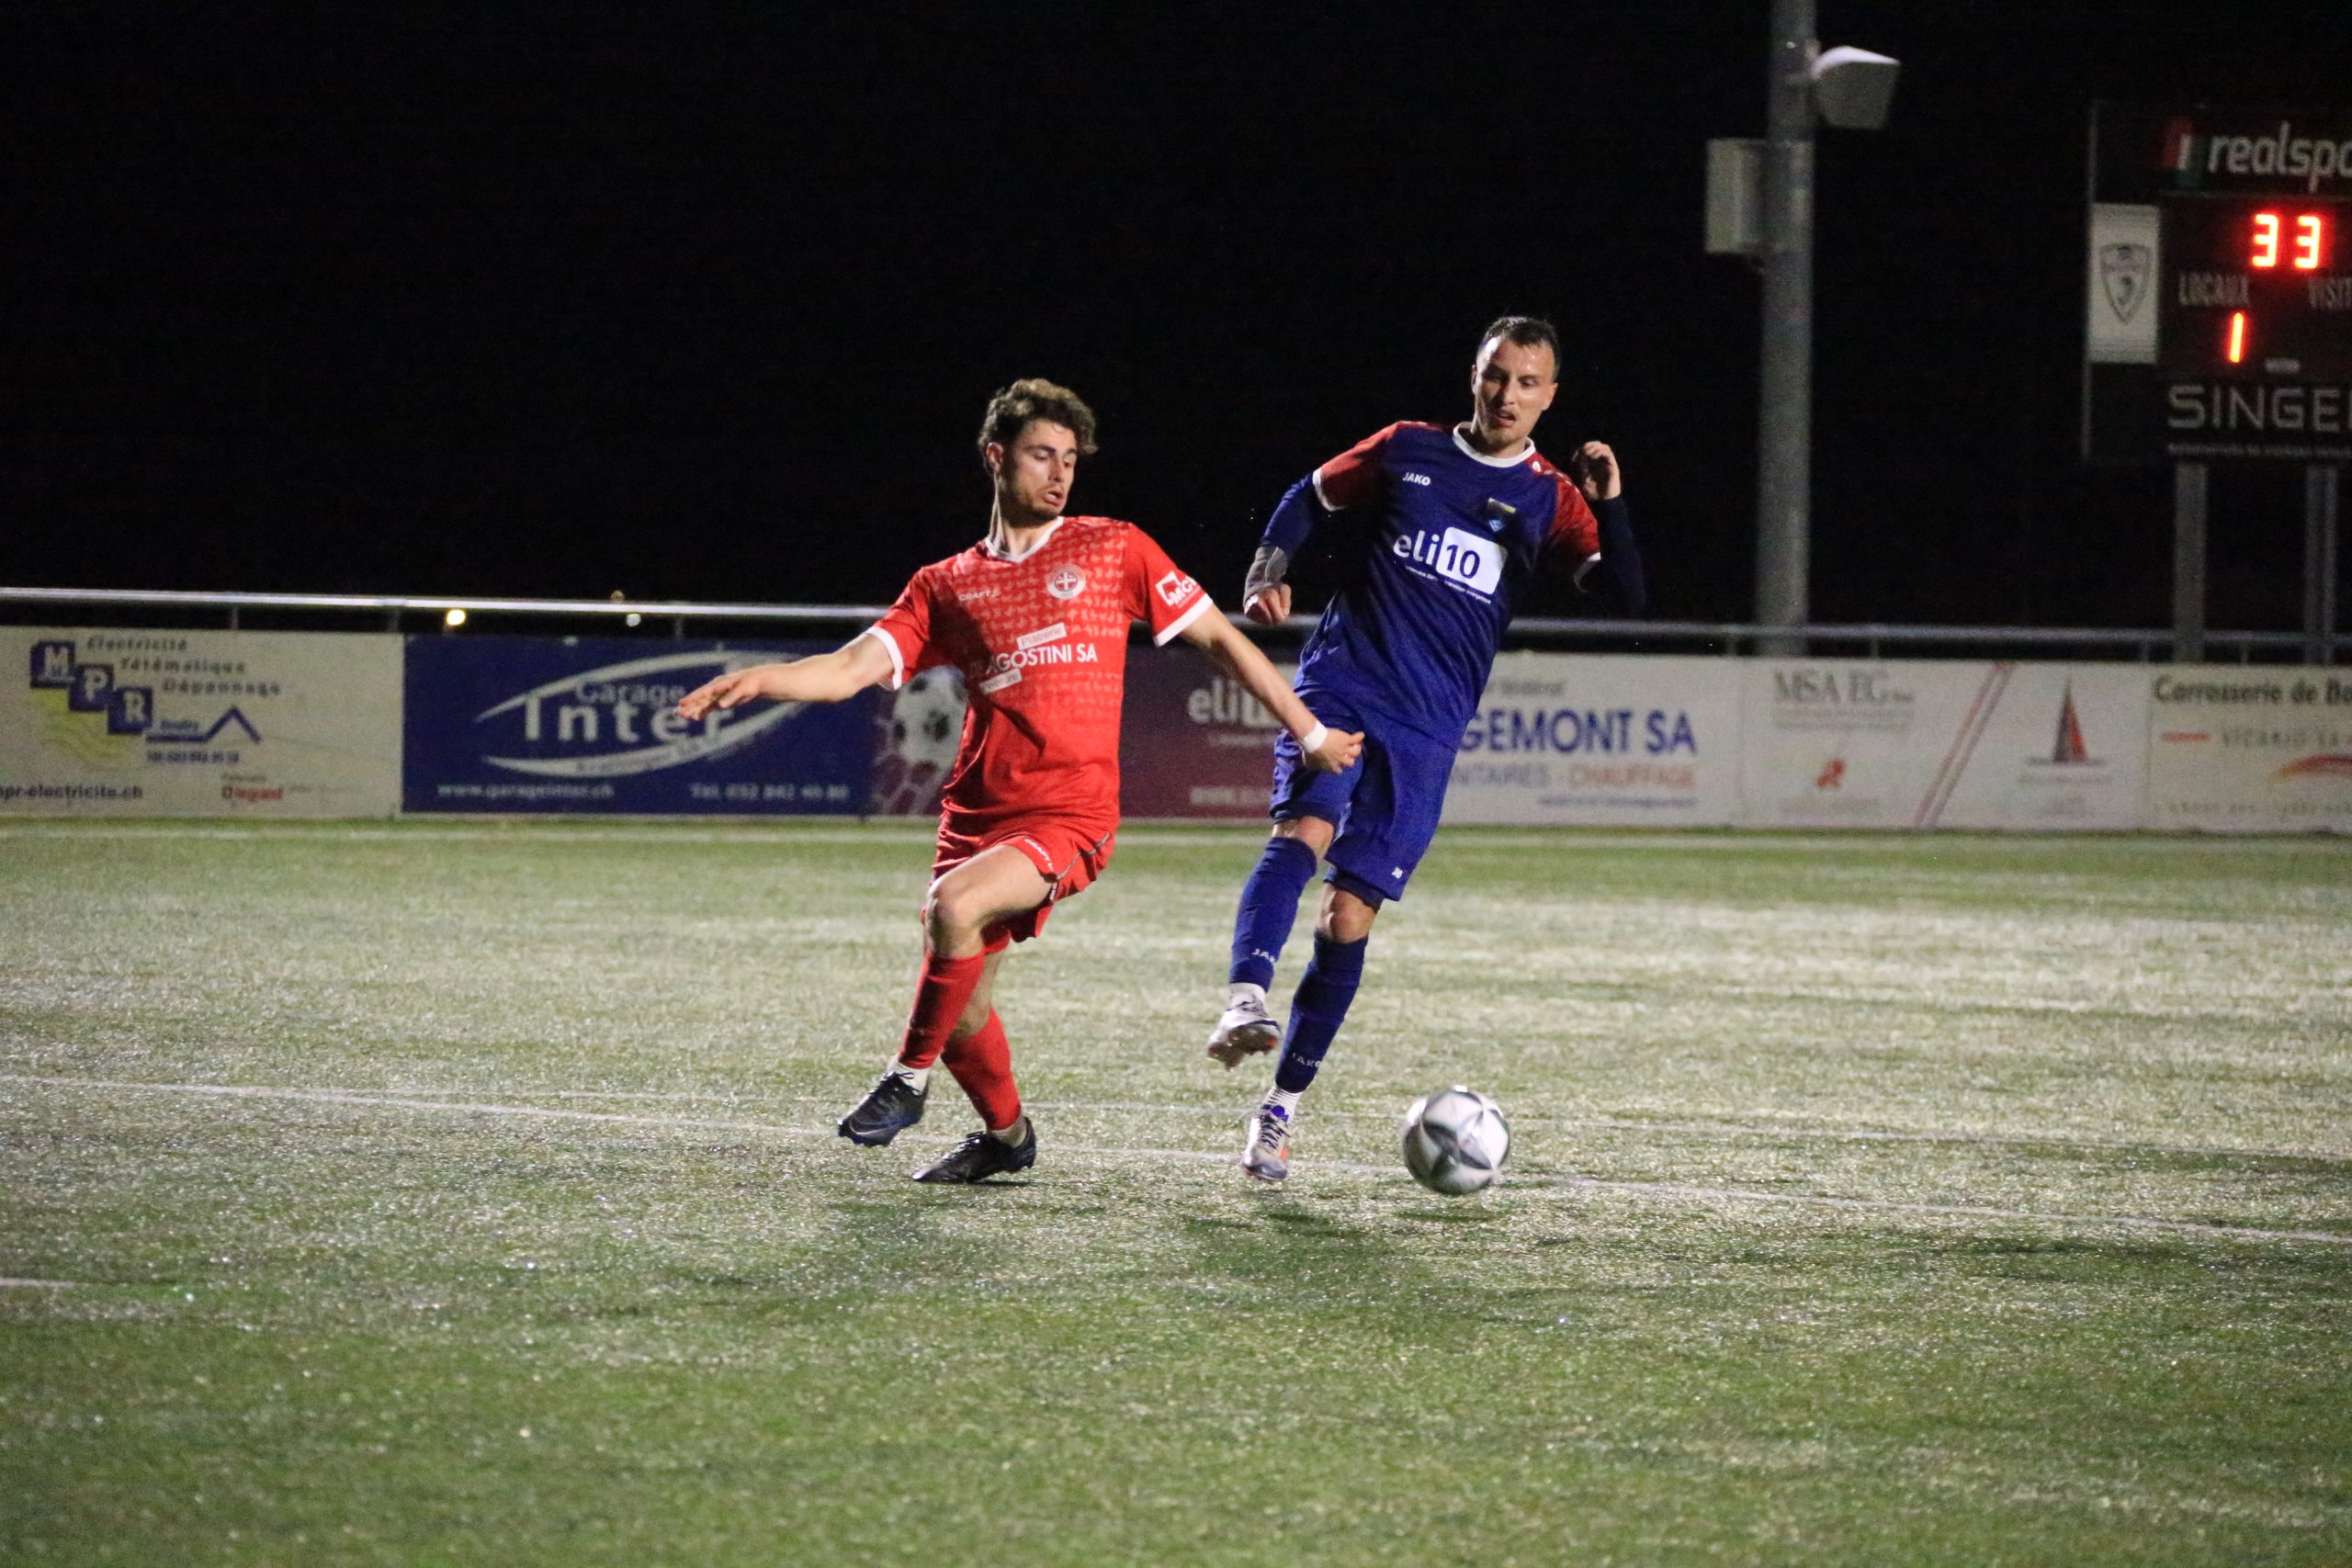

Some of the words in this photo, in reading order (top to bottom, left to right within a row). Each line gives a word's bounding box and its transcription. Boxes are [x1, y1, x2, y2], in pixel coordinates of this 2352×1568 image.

[2166, 384, 2352, 432] SINGE
[1402, 471, 1431, 487] JAKO
[1393, 529, 1481, 581] eli10
[1076, 642, 1098, 662] SA
[575, 681, 685, 708] Garage
[525, 695, 734, 742] Inter
[1645, 707, 1698, 754] SA
